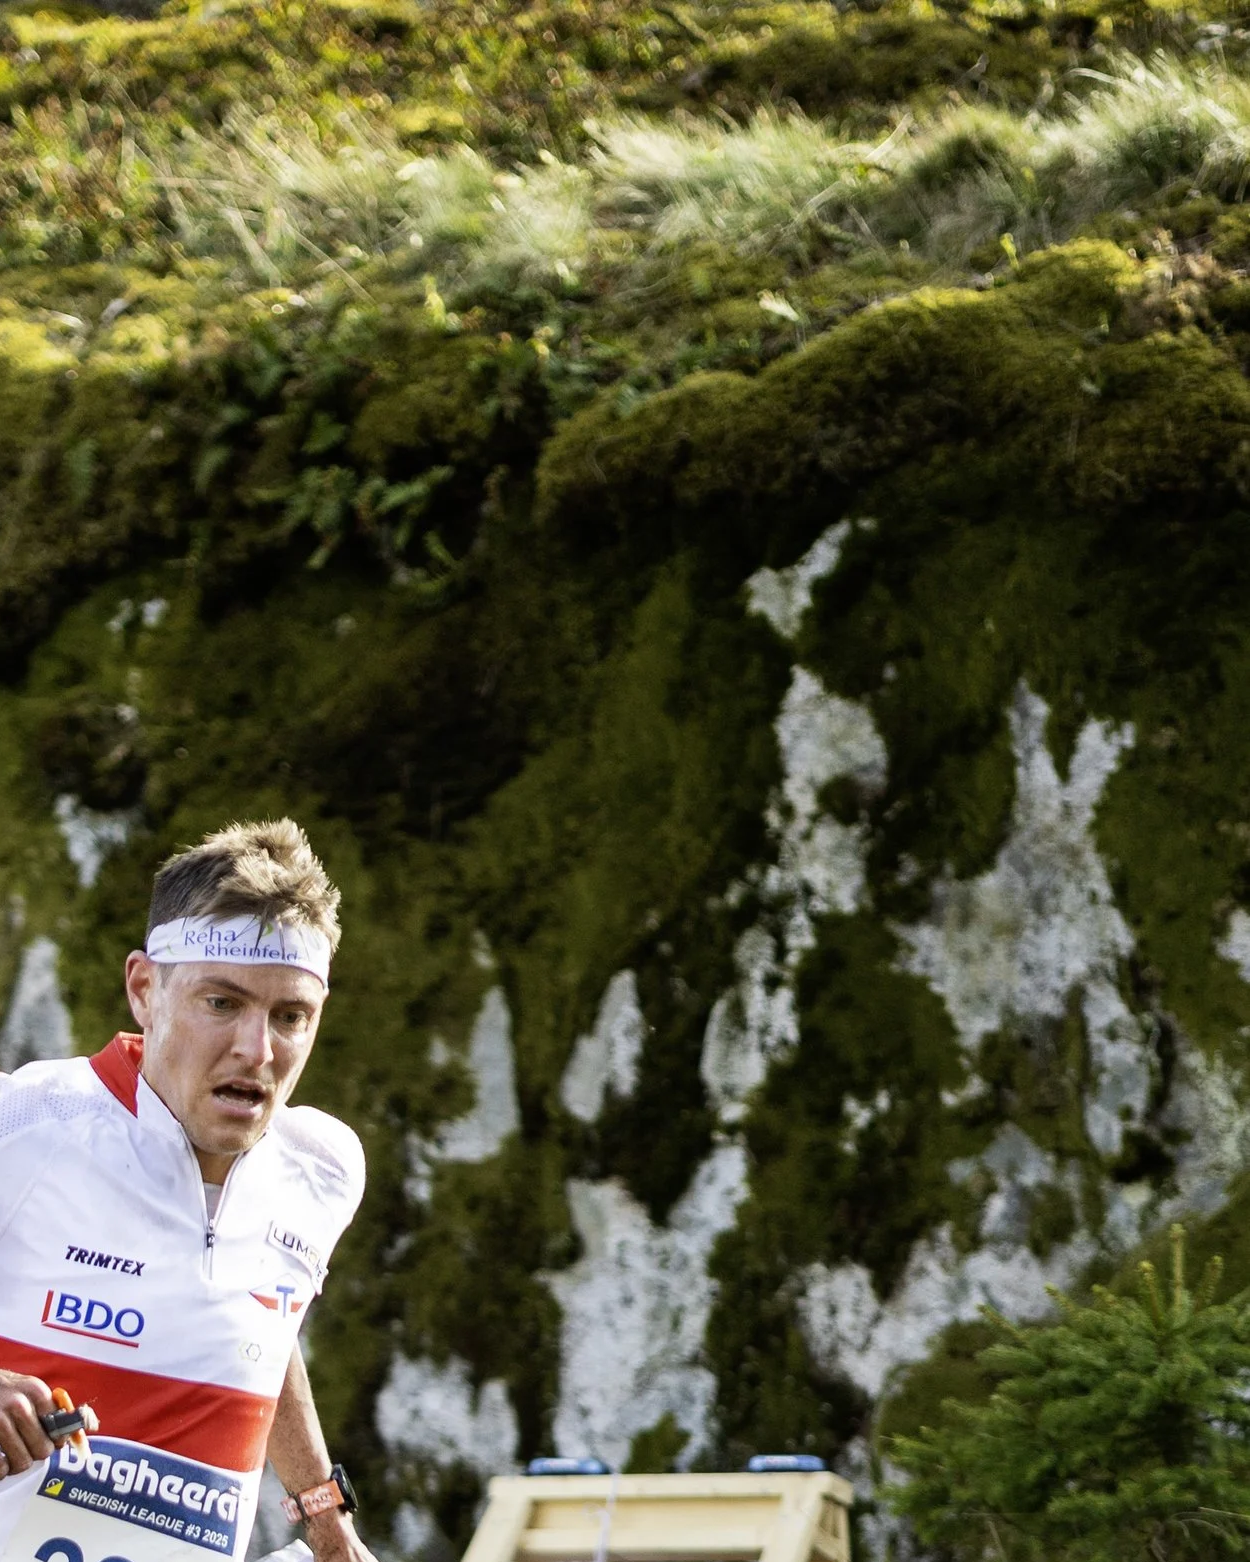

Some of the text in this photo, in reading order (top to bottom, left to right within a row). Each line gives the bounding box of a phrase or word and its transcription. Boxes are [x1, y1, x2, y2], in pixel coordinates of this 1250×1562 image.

[184, 926, 237, 946] Reha
[64, 1245, 147, 1277] TRIMTEX
[55, 1292, 145, 1338] BDO
[69, 1487, 229, 1548] SWEDISH LEAGUE #3 2025
